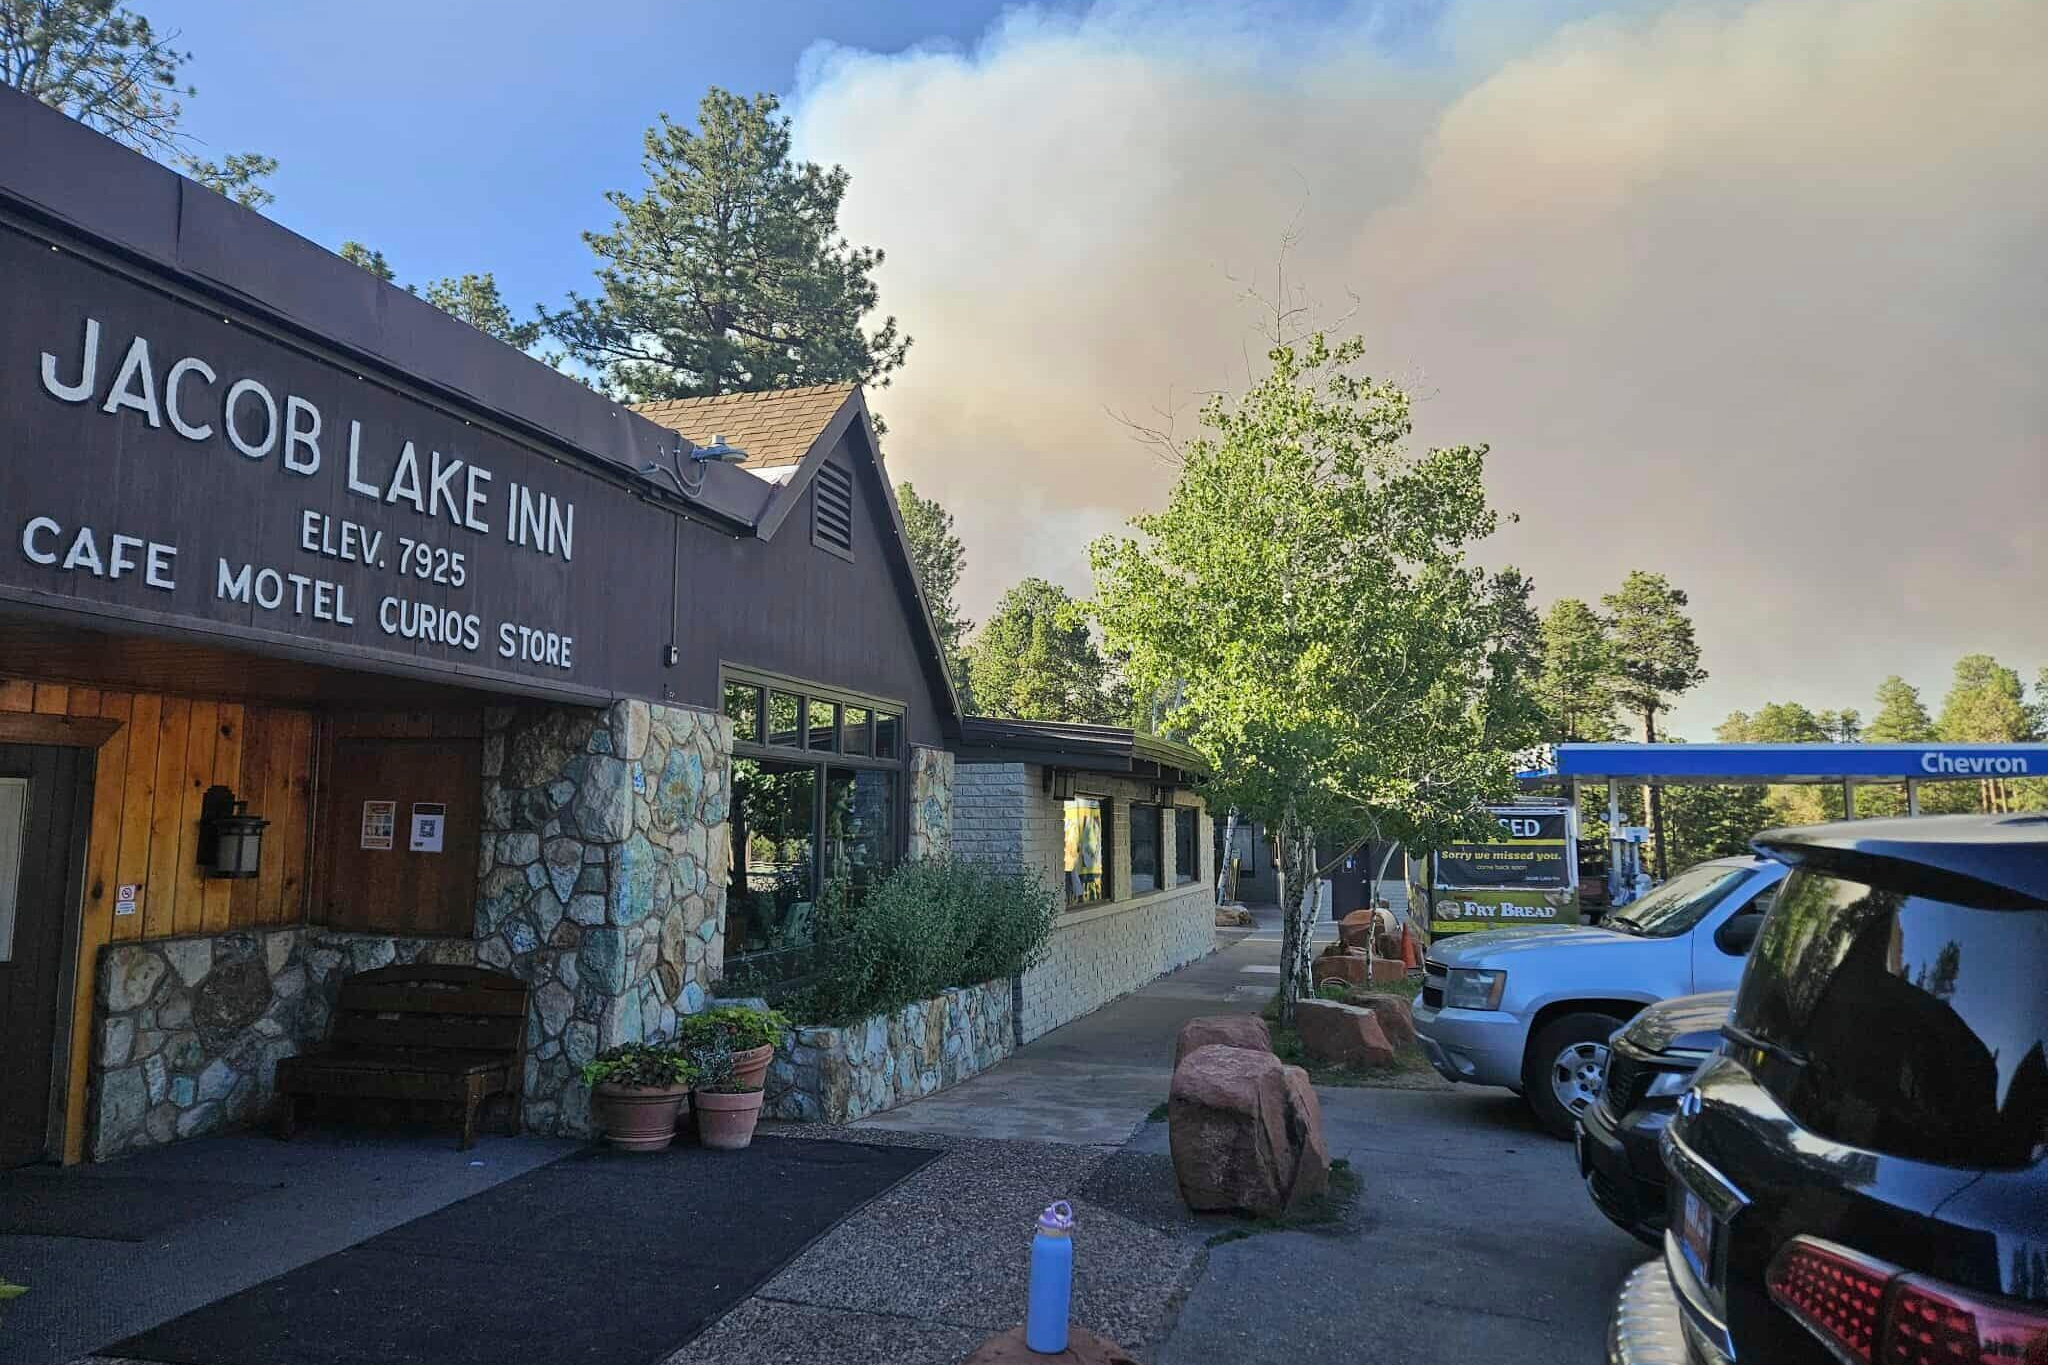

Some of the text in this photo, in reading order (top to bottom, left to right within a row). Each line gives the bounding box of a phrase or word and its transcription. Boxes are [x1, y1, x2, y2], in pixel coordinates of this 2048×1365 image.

[41, 318, 574, 560] JACOB LAKE INN
[302, 509, 466, 587] ELEV. 7925
[23, 517, 572, 668] CAFE MOTEL CURIOS STORE
[1921, 752, 2027, 773] Chevron
[1441, 850, 1472, 861] Sorry
[1474, 852, 1490, 860] we
[1492, 850, 1534, 860] missed
[1463, 901, 1557, 918] FRY BREAD
